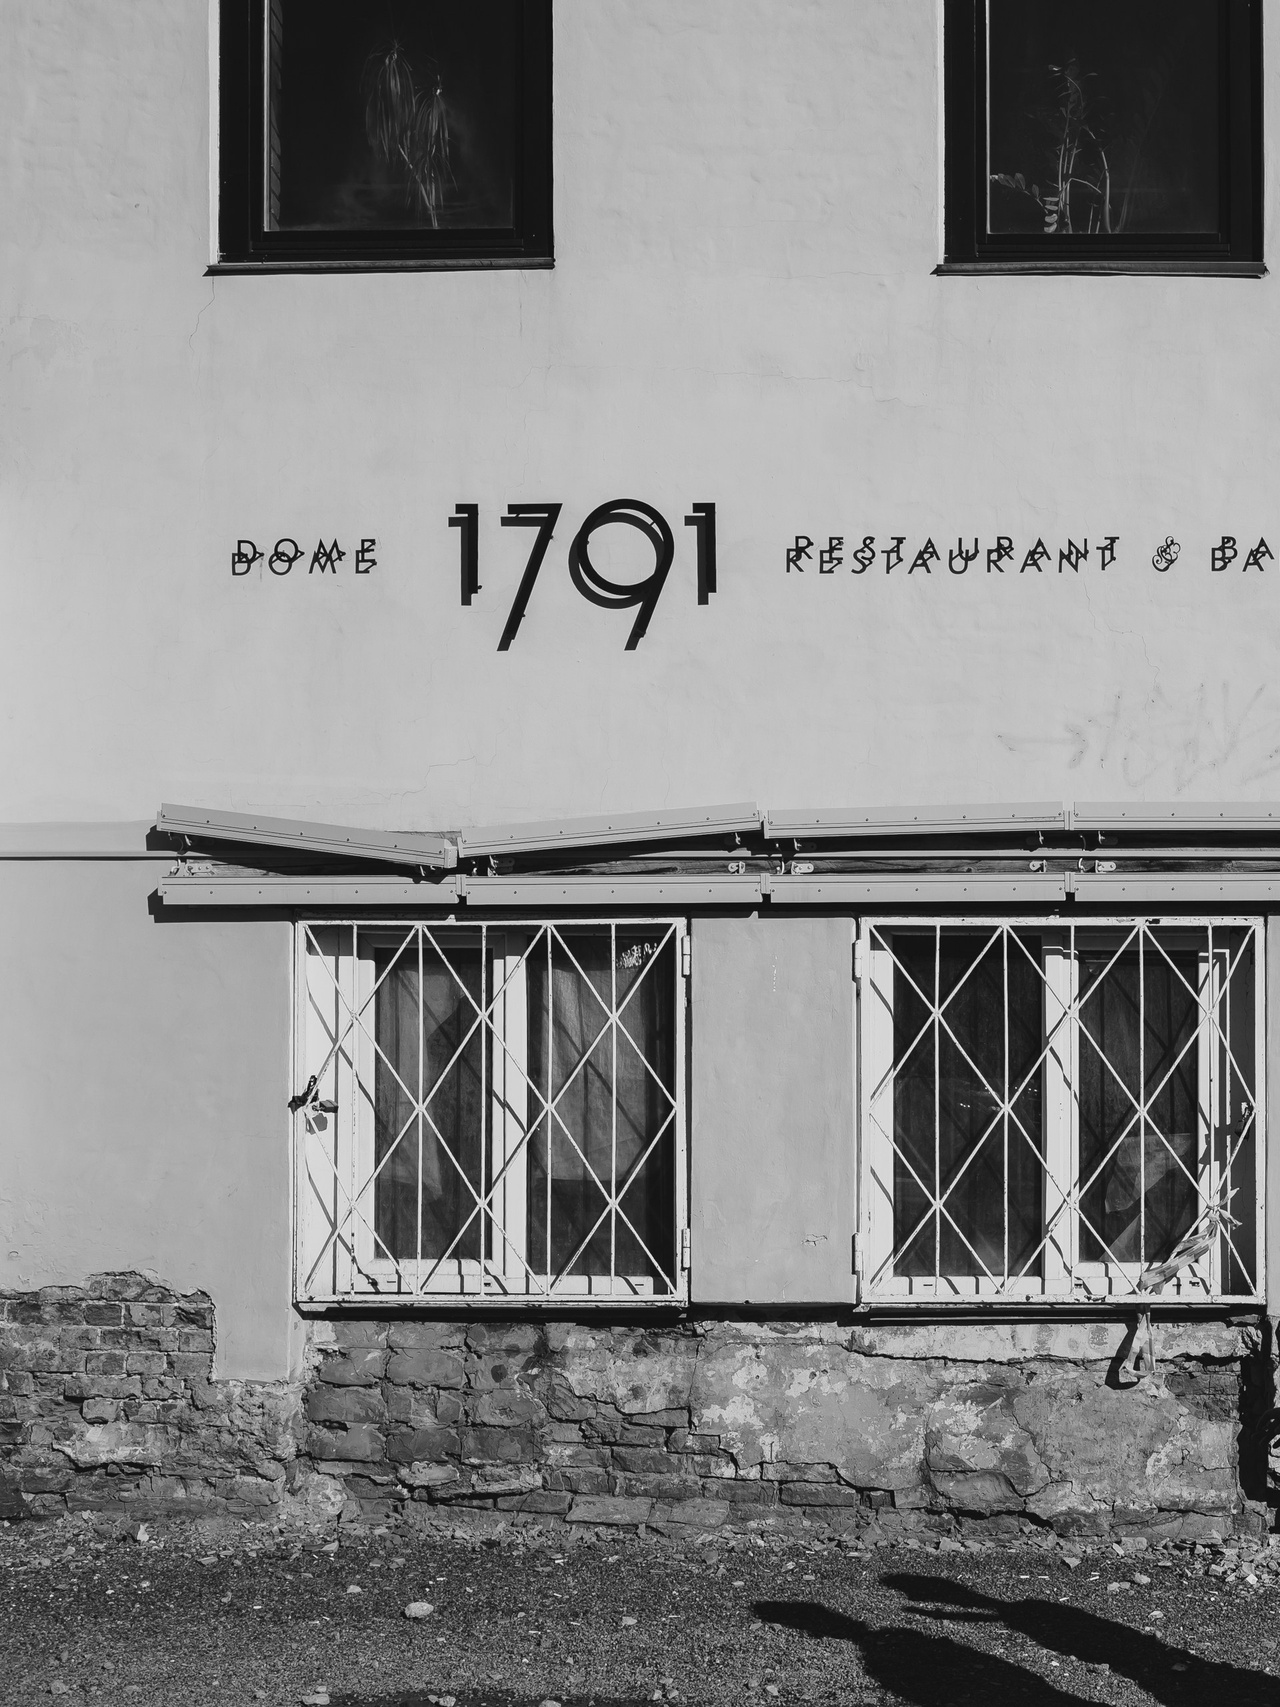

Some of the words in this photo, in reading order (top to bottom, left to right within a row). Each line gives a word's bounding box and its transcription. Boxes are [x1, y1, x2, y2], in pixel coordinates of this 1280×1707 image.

[234, 538, 377, 569] DOME
[451, 498, 718, 645] 1791
[790, 535, 1121, 568] RESTAURANT
